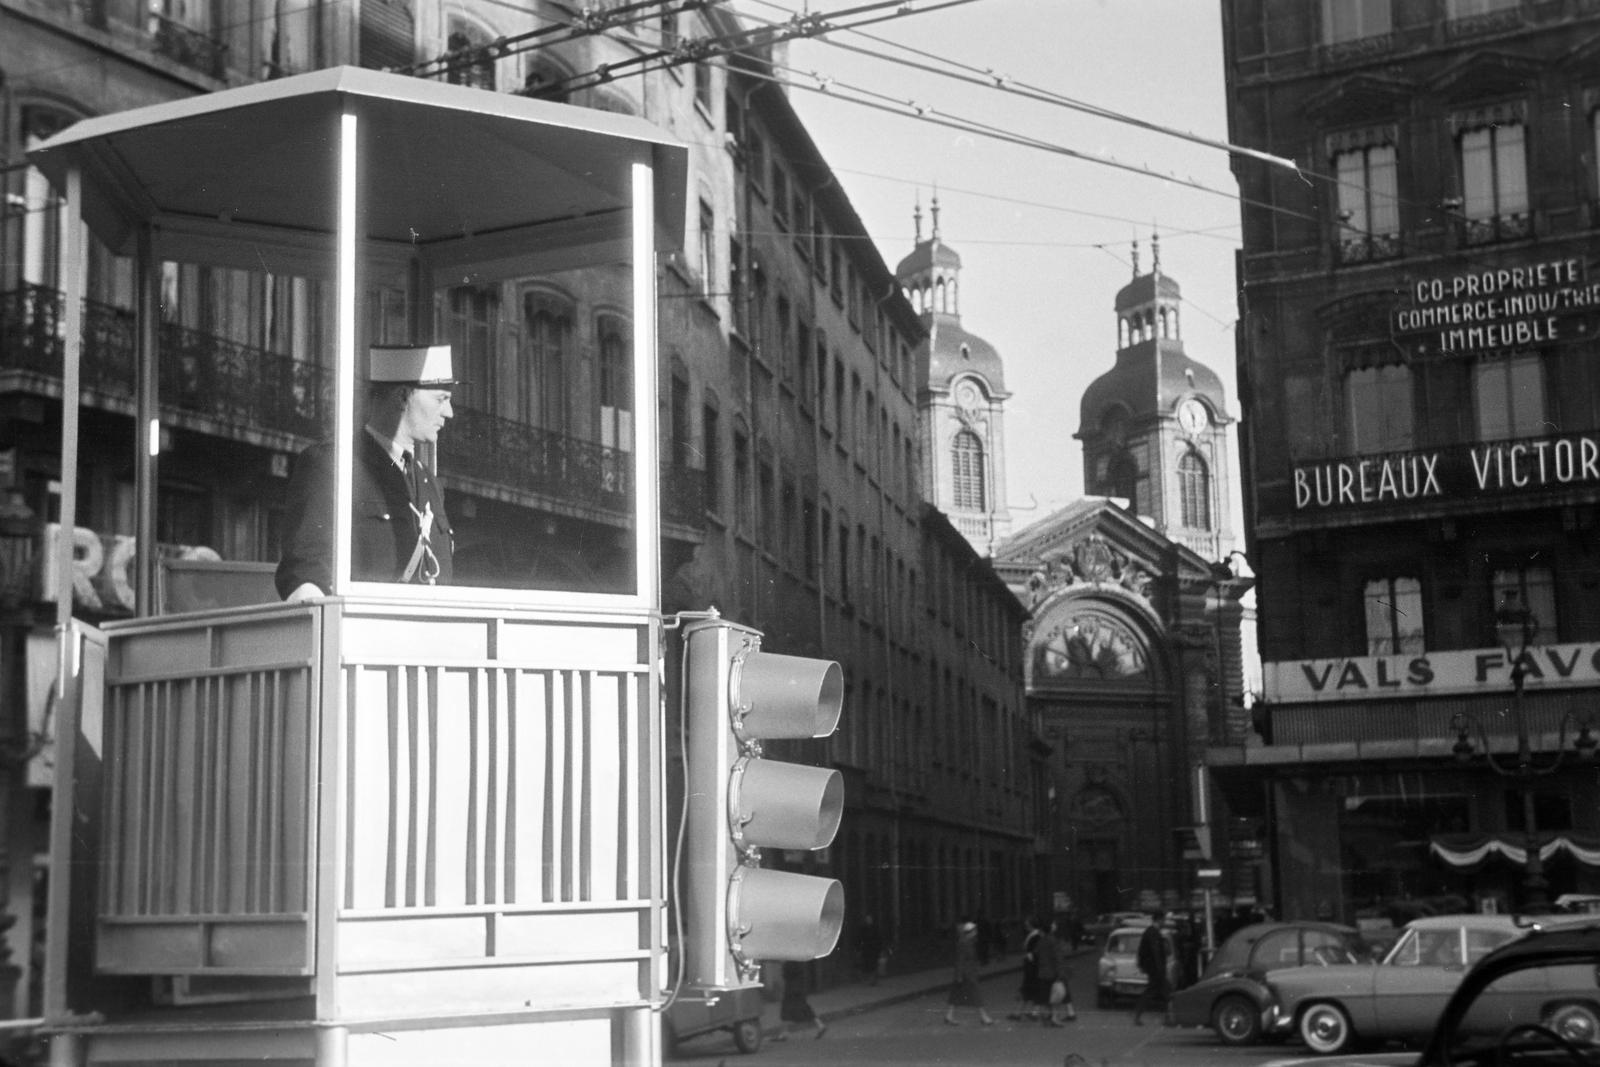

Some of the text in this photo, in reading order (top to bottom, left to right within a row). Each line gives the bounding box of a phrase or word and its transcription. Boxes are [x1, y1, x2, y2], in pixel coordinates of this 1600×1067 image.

[1417, 259, 1577, 303] CO-PROPRIETE
[1441, 317, 1558, 351] IMMEUBLE
[1294, 437, 1600, 509] BUREAUX VICTOR
[1302, 657, 1435, 691] VALS
